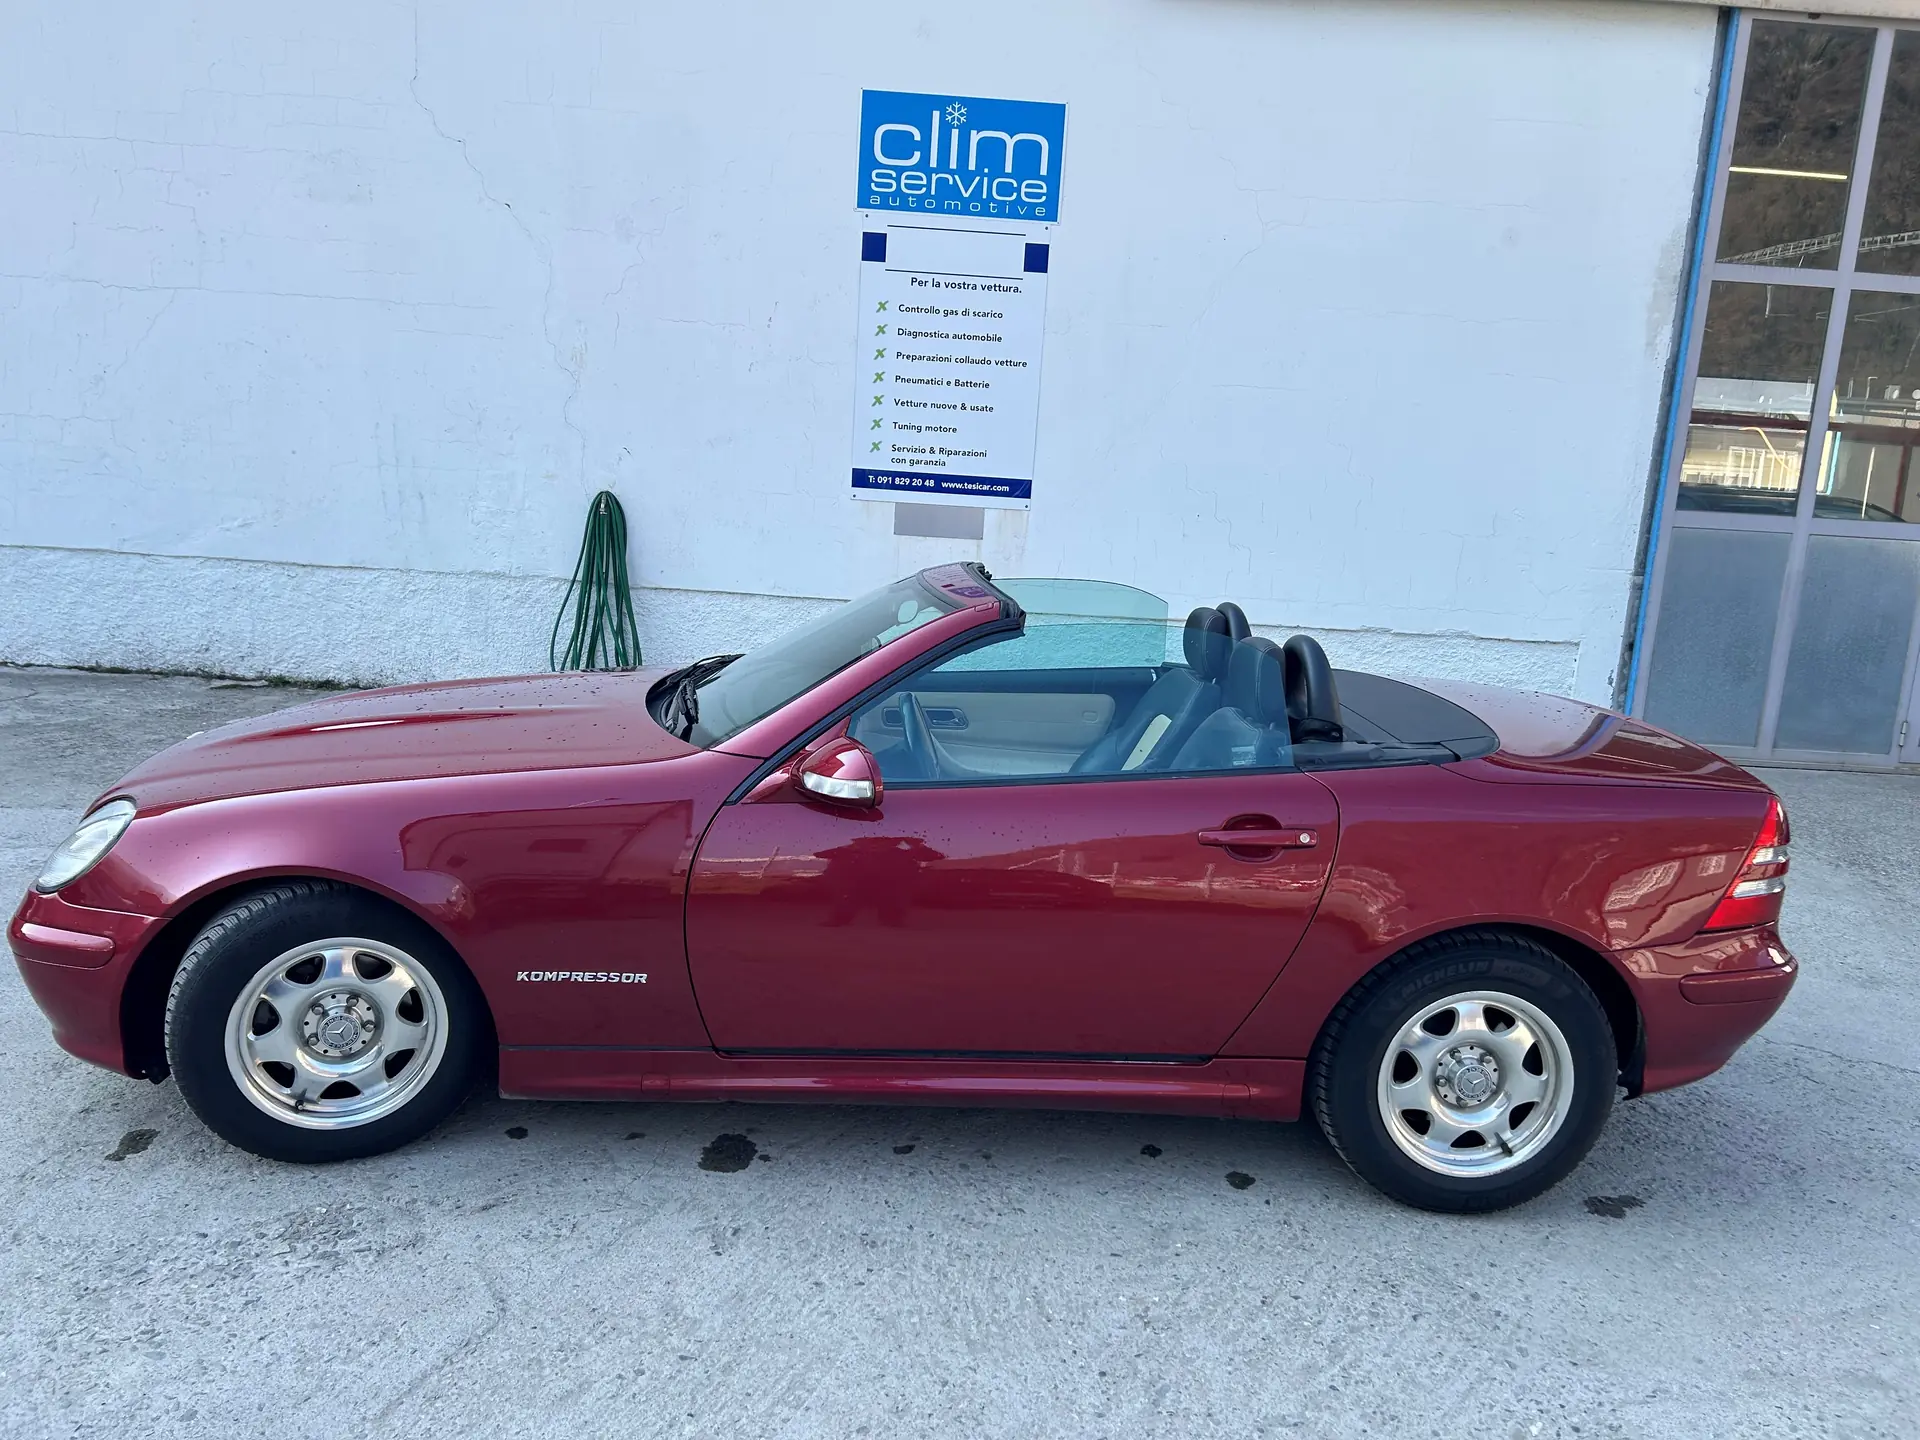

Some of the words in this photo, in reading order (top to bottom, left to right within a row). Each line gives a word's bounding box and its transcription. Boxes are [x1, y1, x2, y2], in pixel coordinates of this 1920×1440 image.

[873, 110, 1049, 176] clim
[870, 167, 1047, 203] service
[869, 195, 1046, 217] automotive
[910, 276, 929, 288] Per
[932, 278, 941, 288] la
[944, 281, 977, 291] vostra
[981, 282, 1022, 294] vettura.
[898, 304, 941, 315] Controllo
[942, 308, 959, 318] gas
[961, 308, 970, 317] di
[972, 309, 1003, 319] scarico
[897, 328, 950, 340] Diagnostica
[952, 331, 1003, 343] automobile
[896, 352, 952, 363] Preparazioni
[954, 356, 992, 366] collaudo
[994, 359, 1028, 368] vetture
[894, 375, 944, 387] Pneumatici
[954, 379, 990, 389] Batterie
[893, 398, 928, 409] Vetture
[930, 402, 958, 410] nuove
[960, 402, 968, 411] &
[970, 404, 994, 413] usate
[892, 422, 922, 433] Tuning
[924, 424, 958, 433] motore
[891, 444, 926, 454] Servizio
[929, 446, 936, 455] &
[939, 447, 987, 459] Riparazioni
[890, 457, 907, 465] con
[909, 458, 946, 467] garanzia
[868, 475, 876, 484] T:
[877, 476, 892, 485] 091
[894, 477, 910, 486] 829
[911, 478, 922, 486] 20
[924, 478, 935, 487] 48
[941, 480, 1010, 493] www.tesicar.com
[516, 971, 648, 983] KOMPRESSOR
